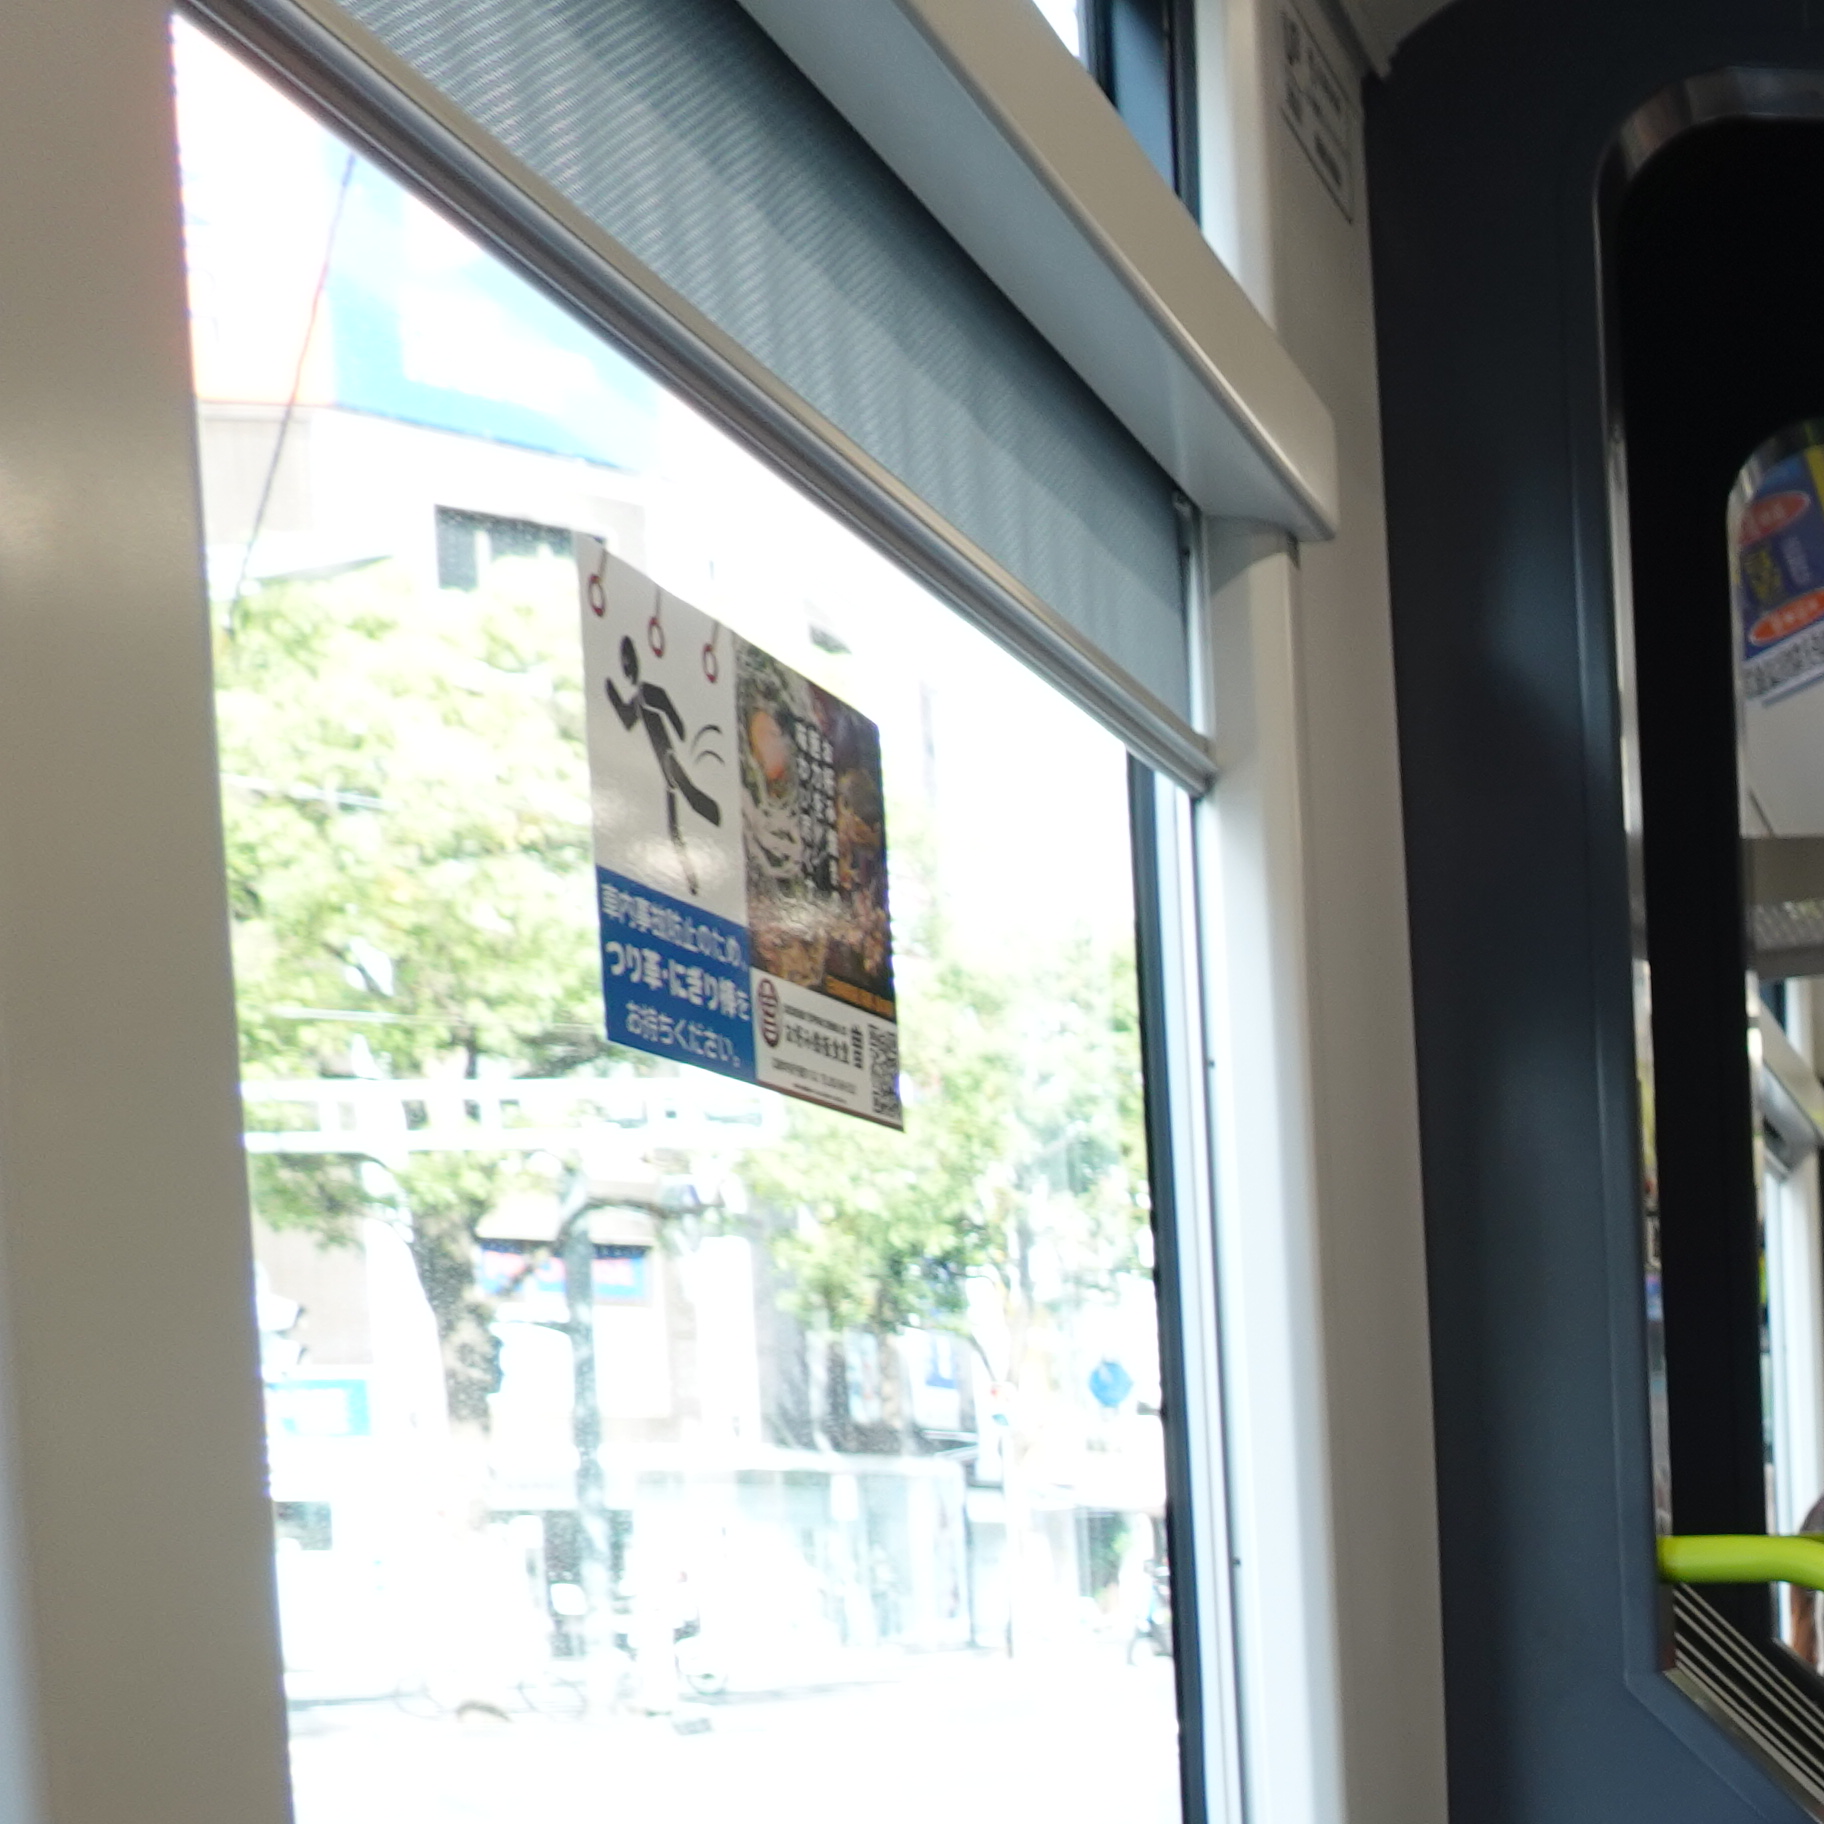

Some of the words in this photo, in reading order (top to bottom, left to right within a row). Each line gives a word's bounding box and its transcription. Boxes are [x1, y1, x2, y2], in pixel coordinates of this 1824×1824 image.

[626, 1000, 741, 1069] お持ちください。
